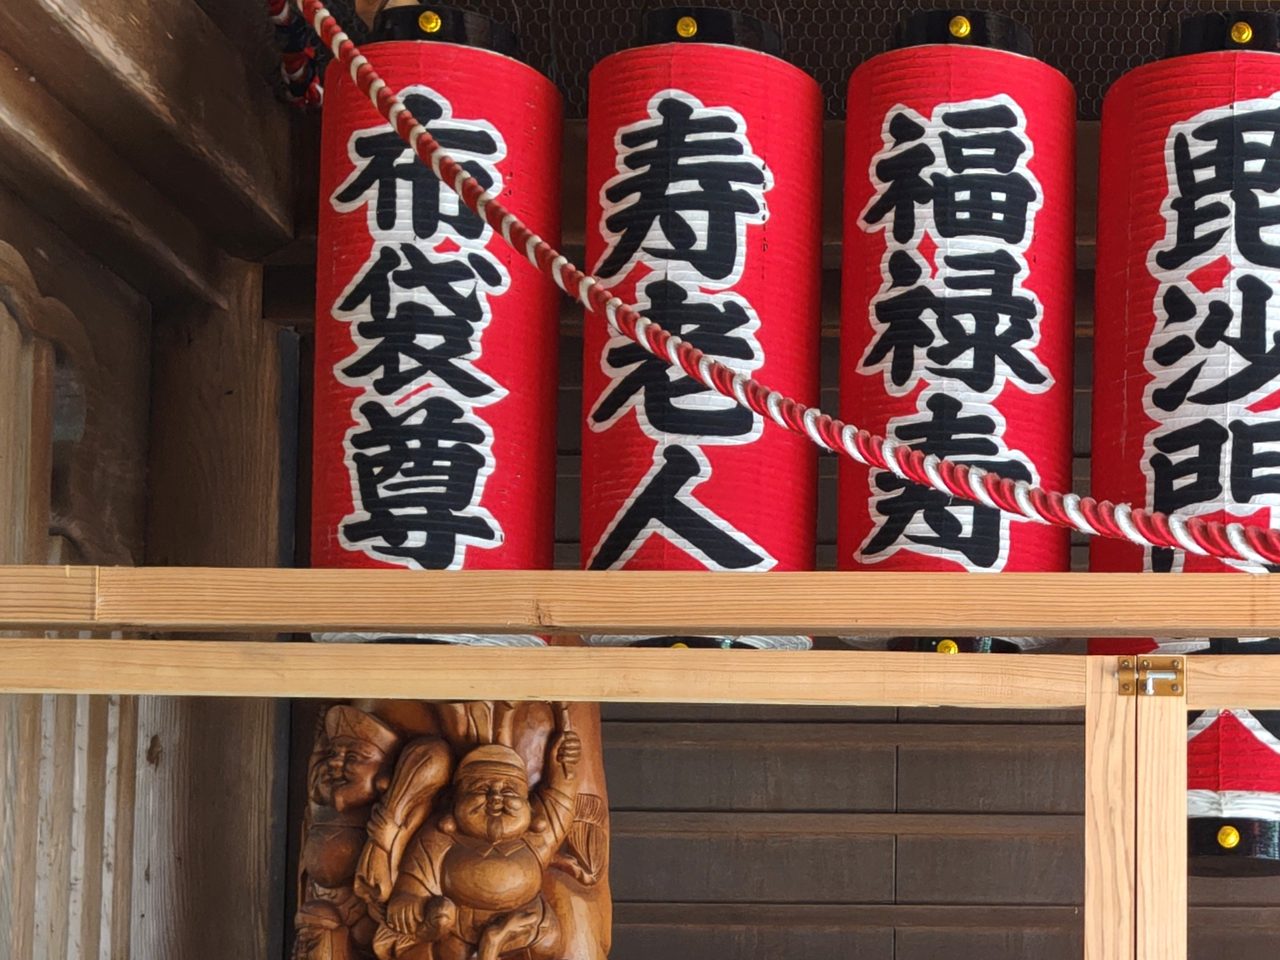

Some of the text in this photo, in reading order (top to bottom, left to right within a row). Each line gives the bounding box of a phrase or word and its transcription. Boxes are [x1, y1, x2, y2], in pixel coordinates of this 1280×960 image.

[333, 90, 505, 570] 布袋尊
[589, 94, 769, 570] 寿老人
[862, 100, 1050, 567] 福禄寿
